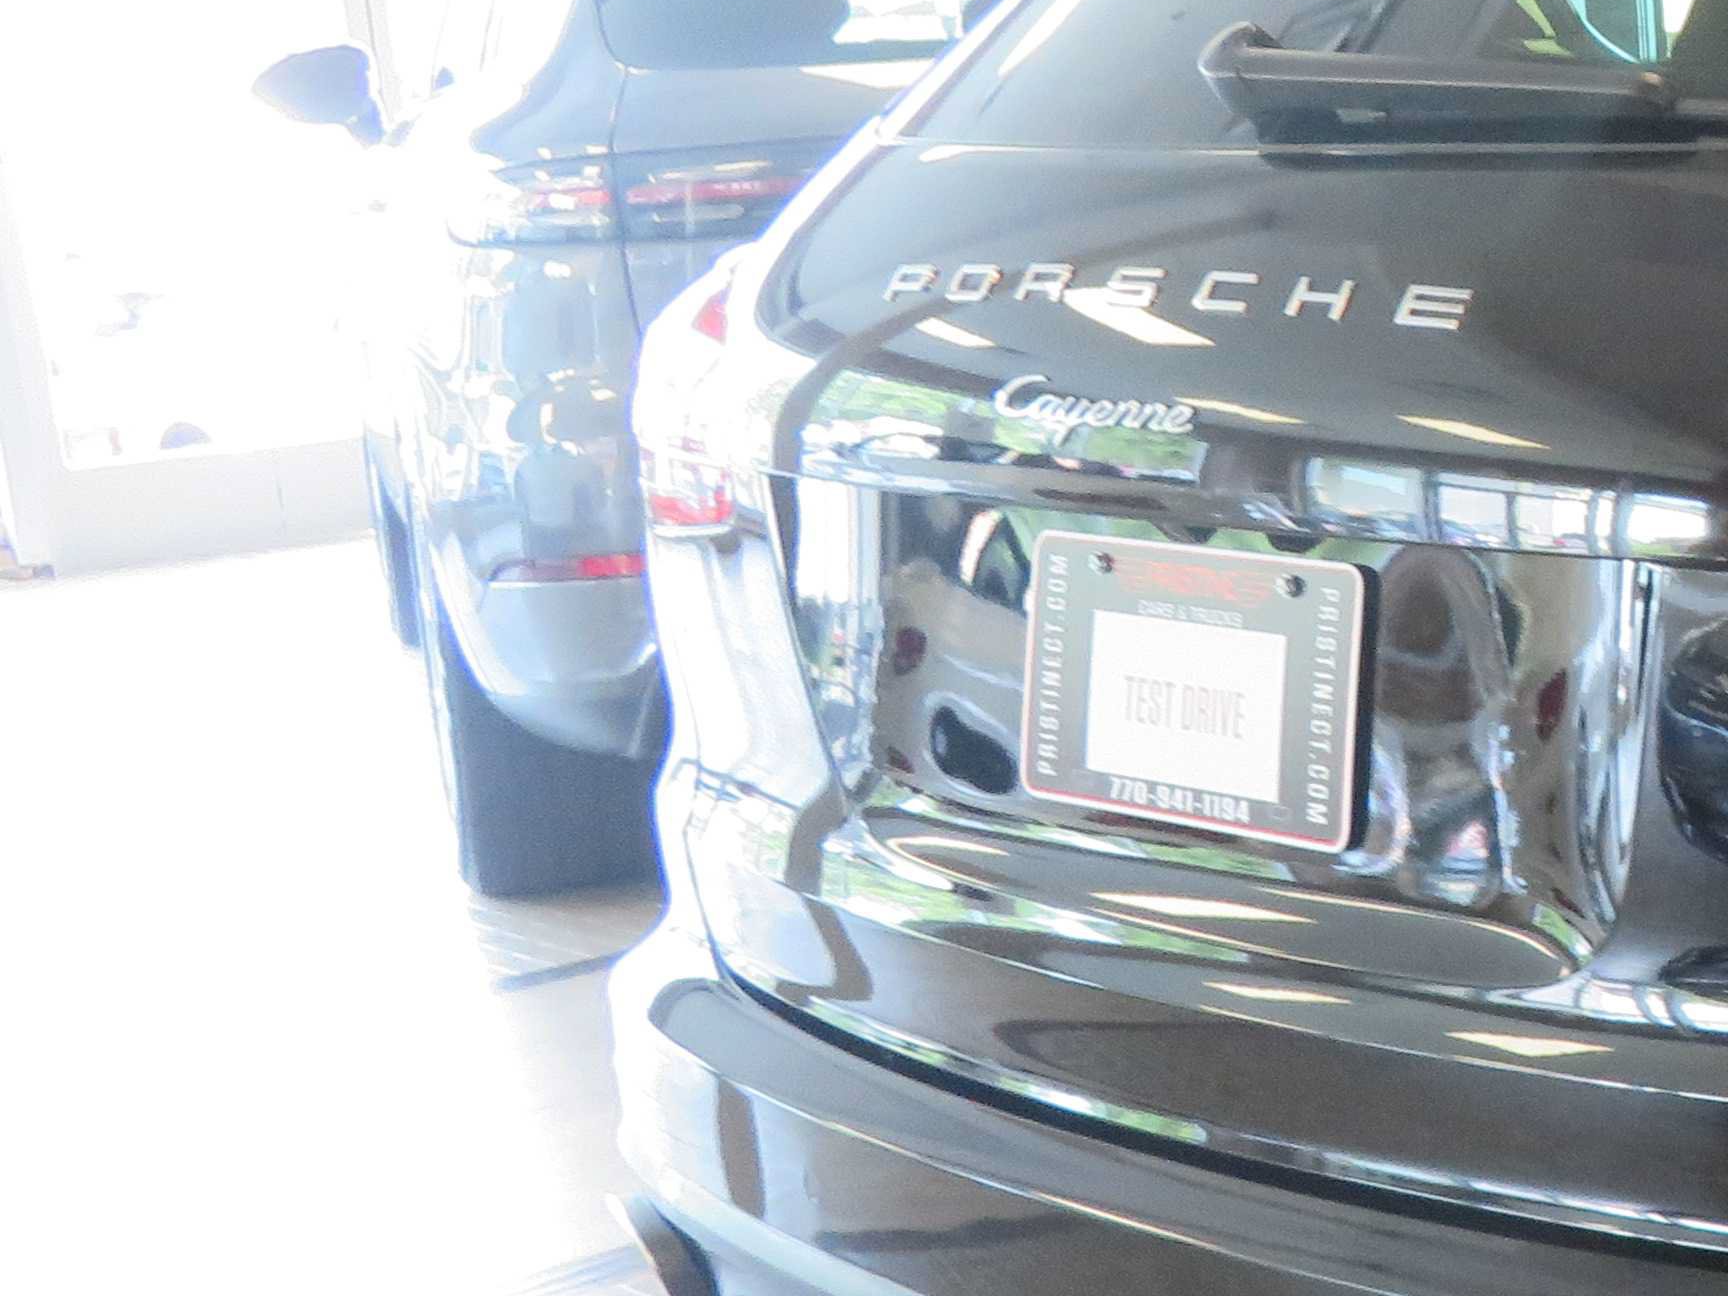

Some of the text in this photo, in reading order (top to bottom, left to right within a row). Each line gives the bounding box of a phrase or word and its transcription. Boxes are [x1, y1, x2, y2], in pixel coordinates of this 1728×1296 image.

[882, 261, 1475, 331] PORSCHE
[994, 373, 1198, 446] Cayenne
[1123, 675, 1247, 740] TEST DRIVE
